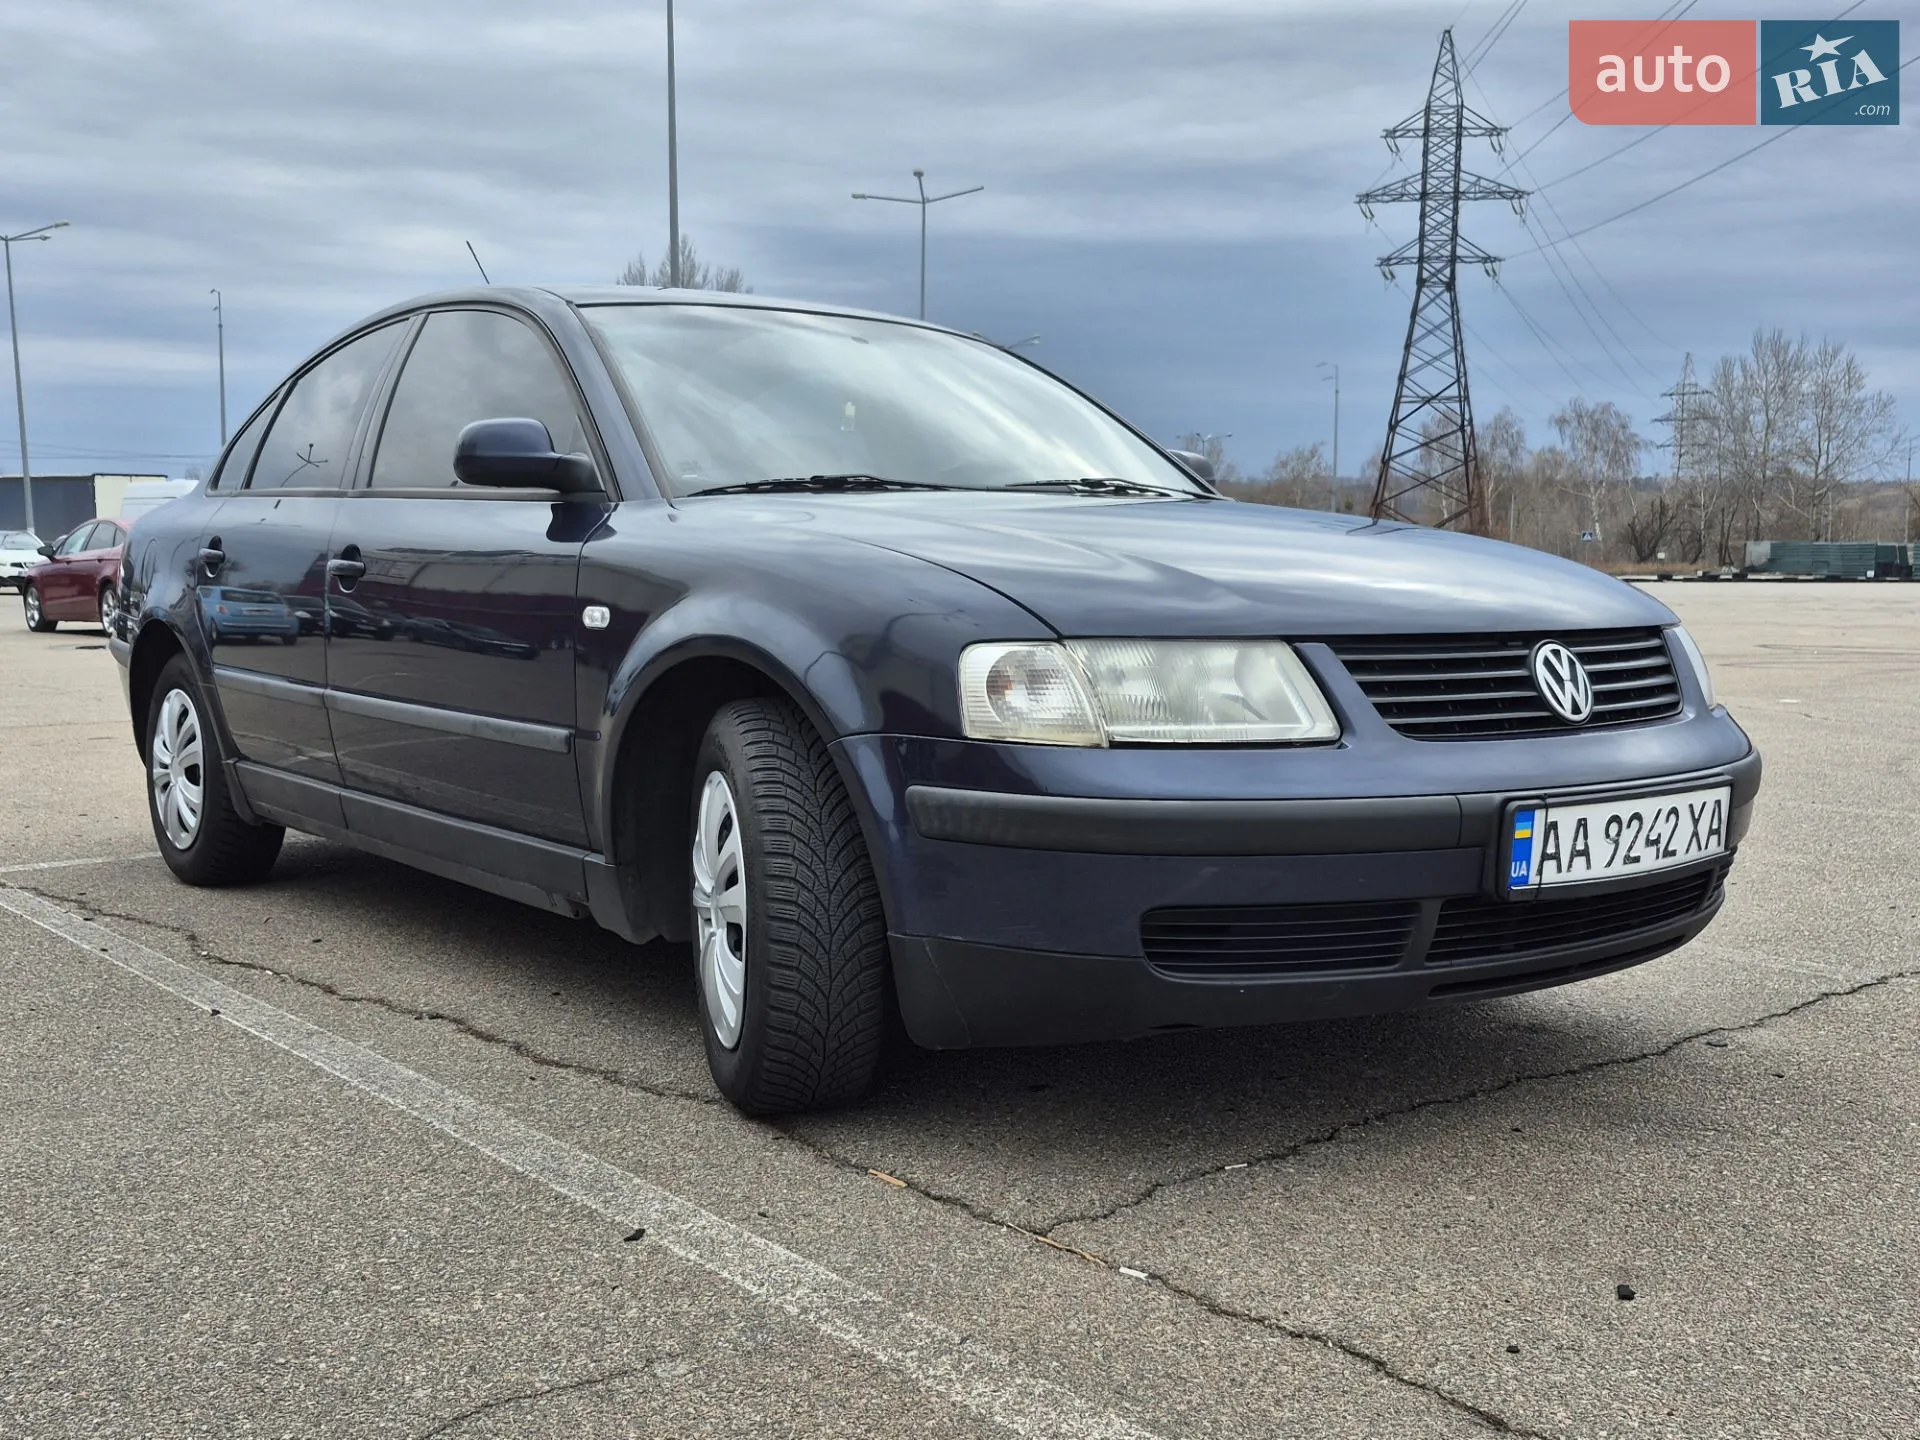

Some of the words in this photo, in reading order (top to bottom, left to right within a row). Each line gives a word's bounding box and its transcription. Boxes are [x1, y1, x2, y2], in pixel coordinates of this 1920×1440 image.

[1535, 817, 1592, 876] AA
[1603, 806, 1680, 868] 9242
[1685, 799, 1723, 854] XA
[1511, 860, 1528, 878] UA
